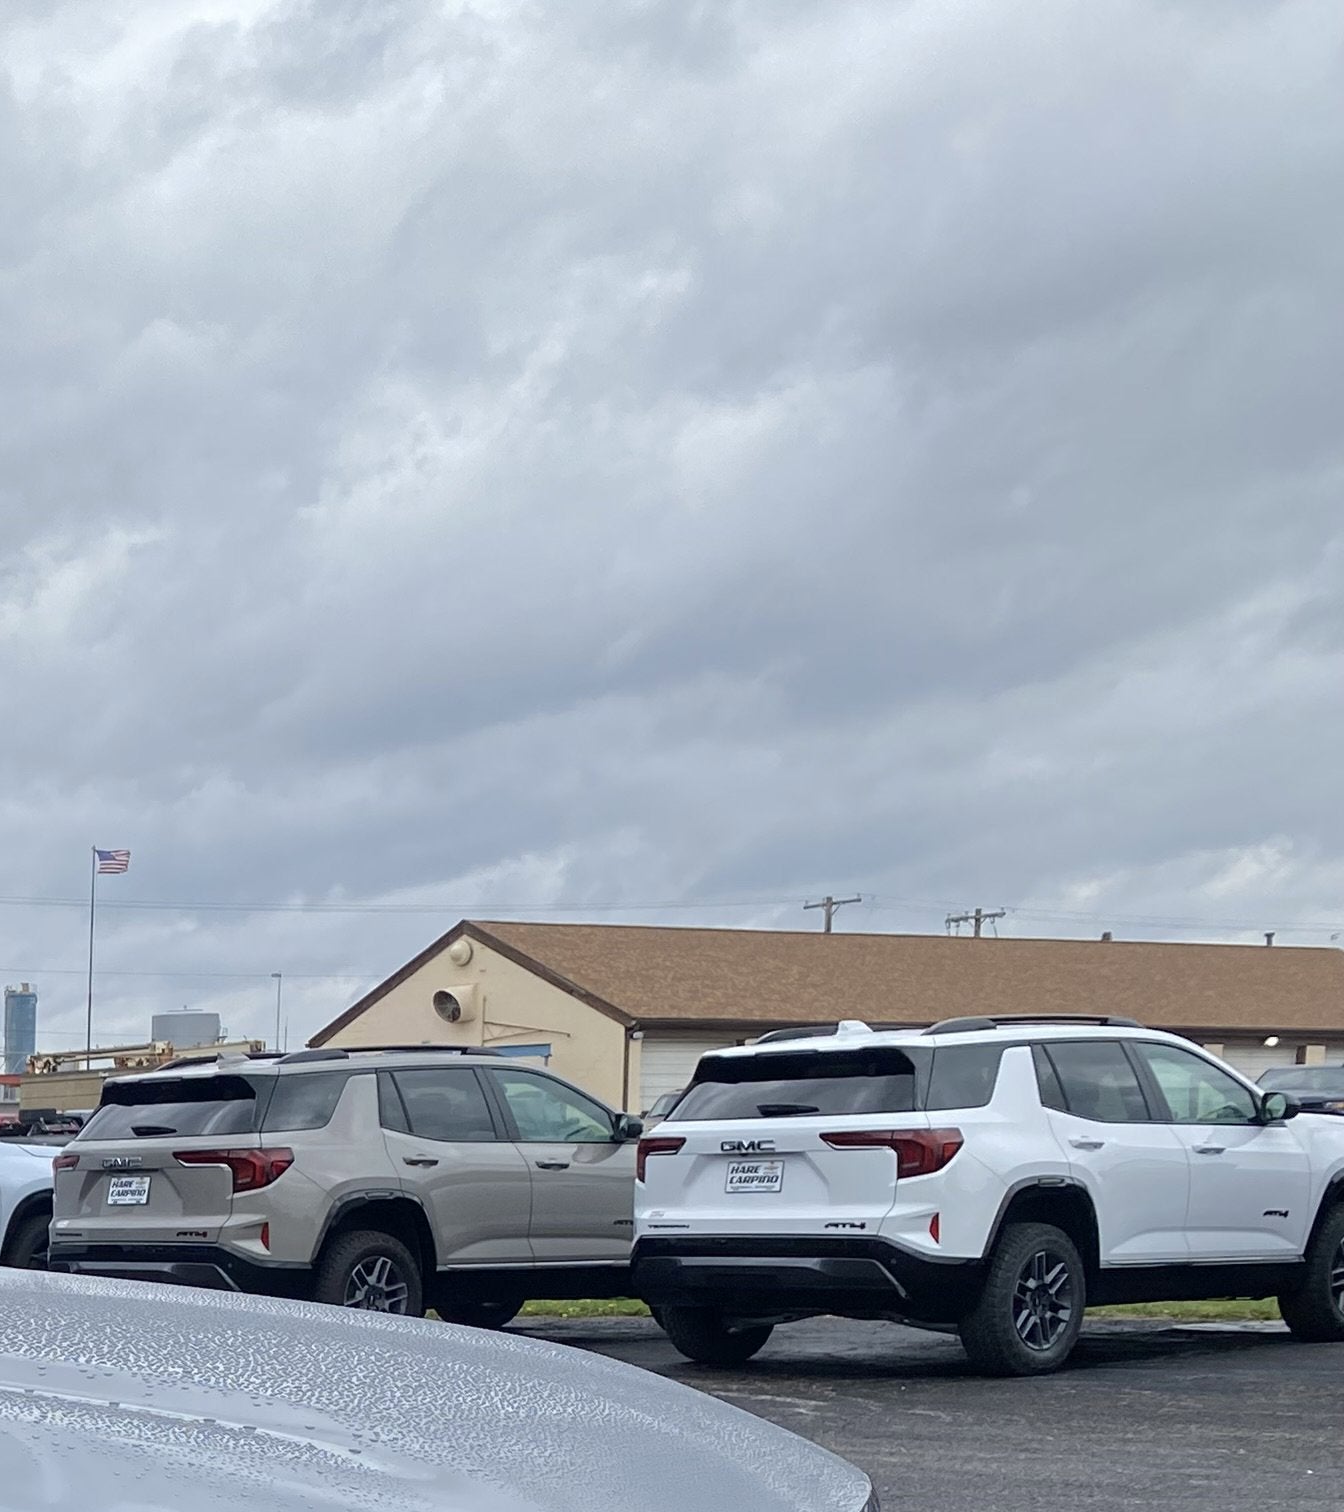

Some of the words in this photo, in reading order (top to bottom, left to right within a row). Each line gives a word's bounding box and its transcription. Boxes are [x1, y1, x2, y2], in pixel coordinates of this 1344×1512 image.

[720, 1139, 776, 1152] GMC
[730, 1165, 761, 1174] HARE
[729, 1175, 779, 1184] CARPINO
